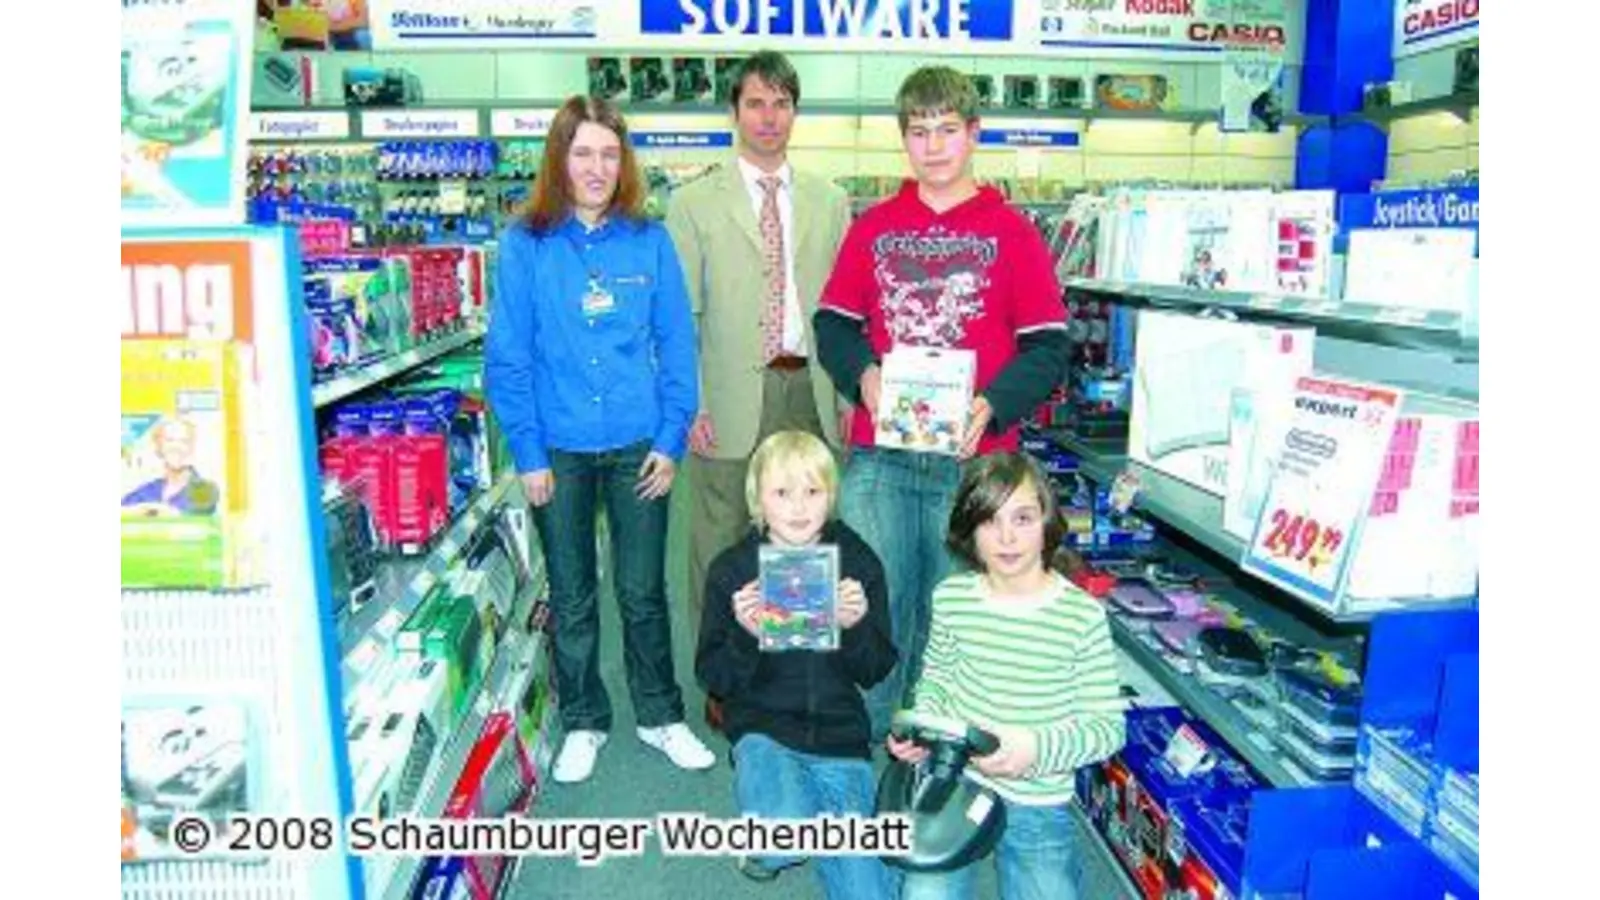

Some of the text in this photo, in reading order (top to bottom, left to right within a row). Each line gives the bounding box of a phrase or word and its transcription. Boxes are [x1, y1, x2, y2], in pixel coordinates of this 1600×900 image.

[1125, 0, 1194, 16] Kodak
[1403, 0, 1479, 35] CASIO
[679, 0, 971, 41] SOFTWARE
[1187, 23, 1286, 45] CASIO
[1294, 396, 1358, 420] expert
